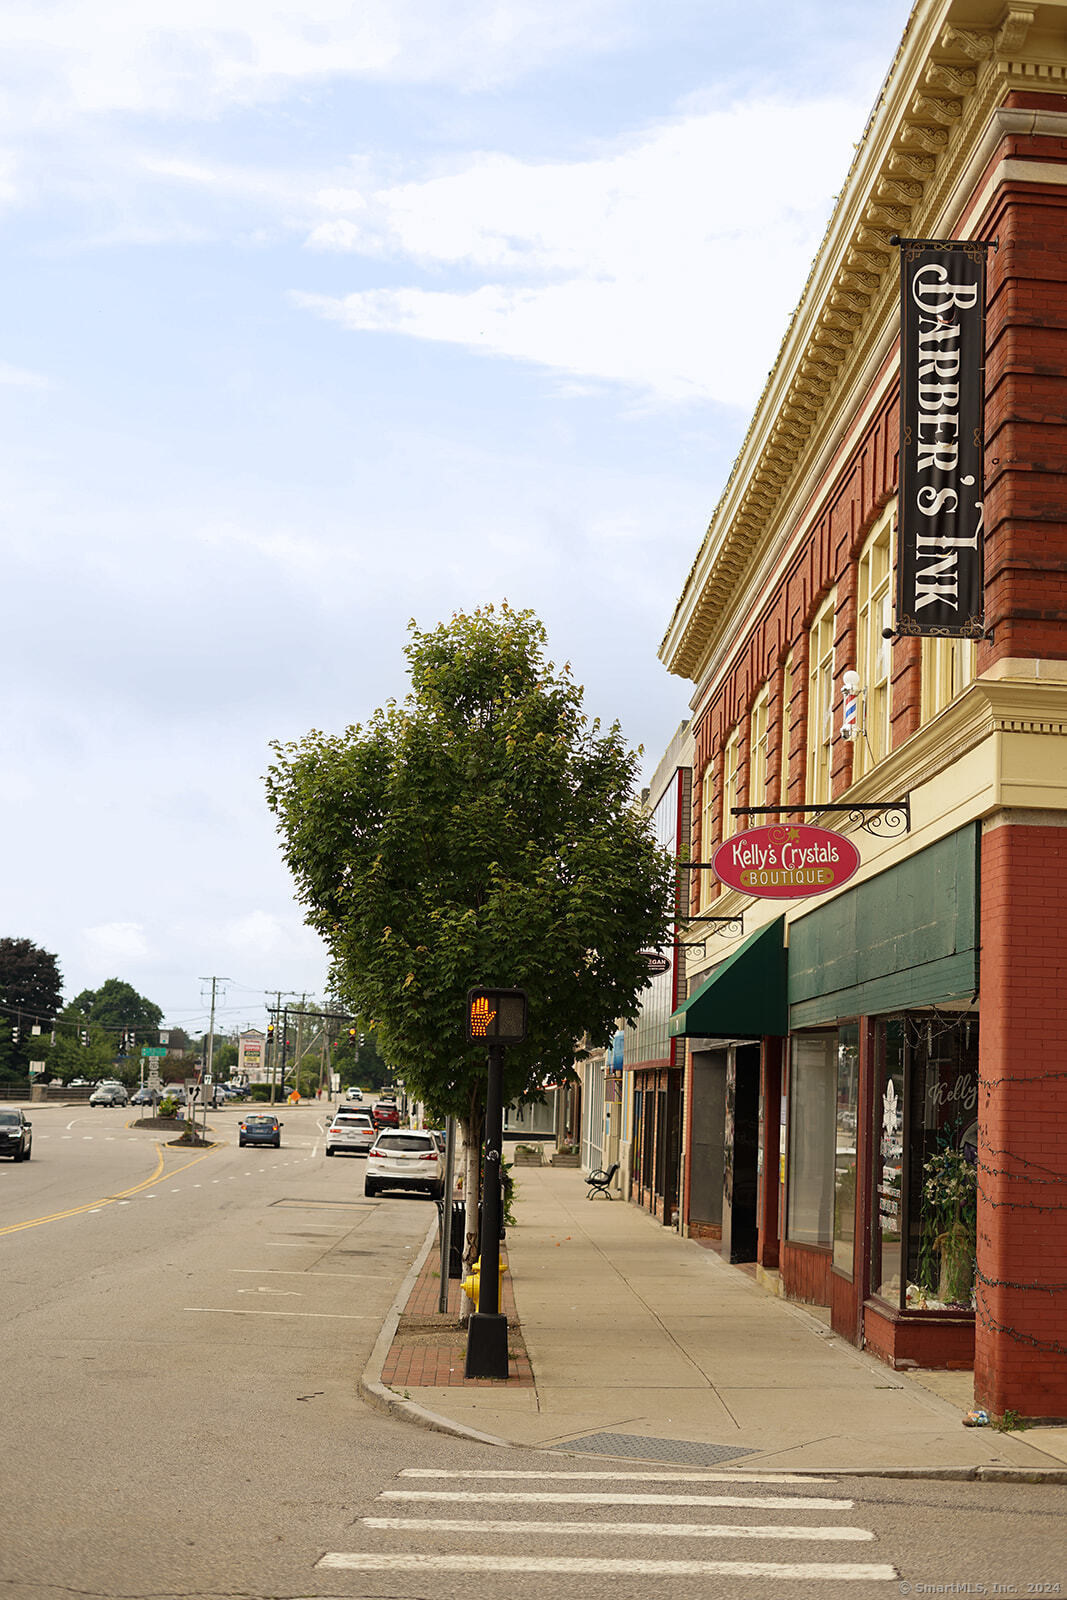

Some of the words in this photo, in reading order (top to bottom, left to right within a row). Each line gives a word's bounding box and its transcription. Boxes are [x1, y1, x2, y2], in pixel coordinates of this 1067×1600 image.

[732, 839, 778, 870] Kelly's
[781, 841, 840, 872] Crystals
[749, 869, 825, 885] BOUTIQUE
